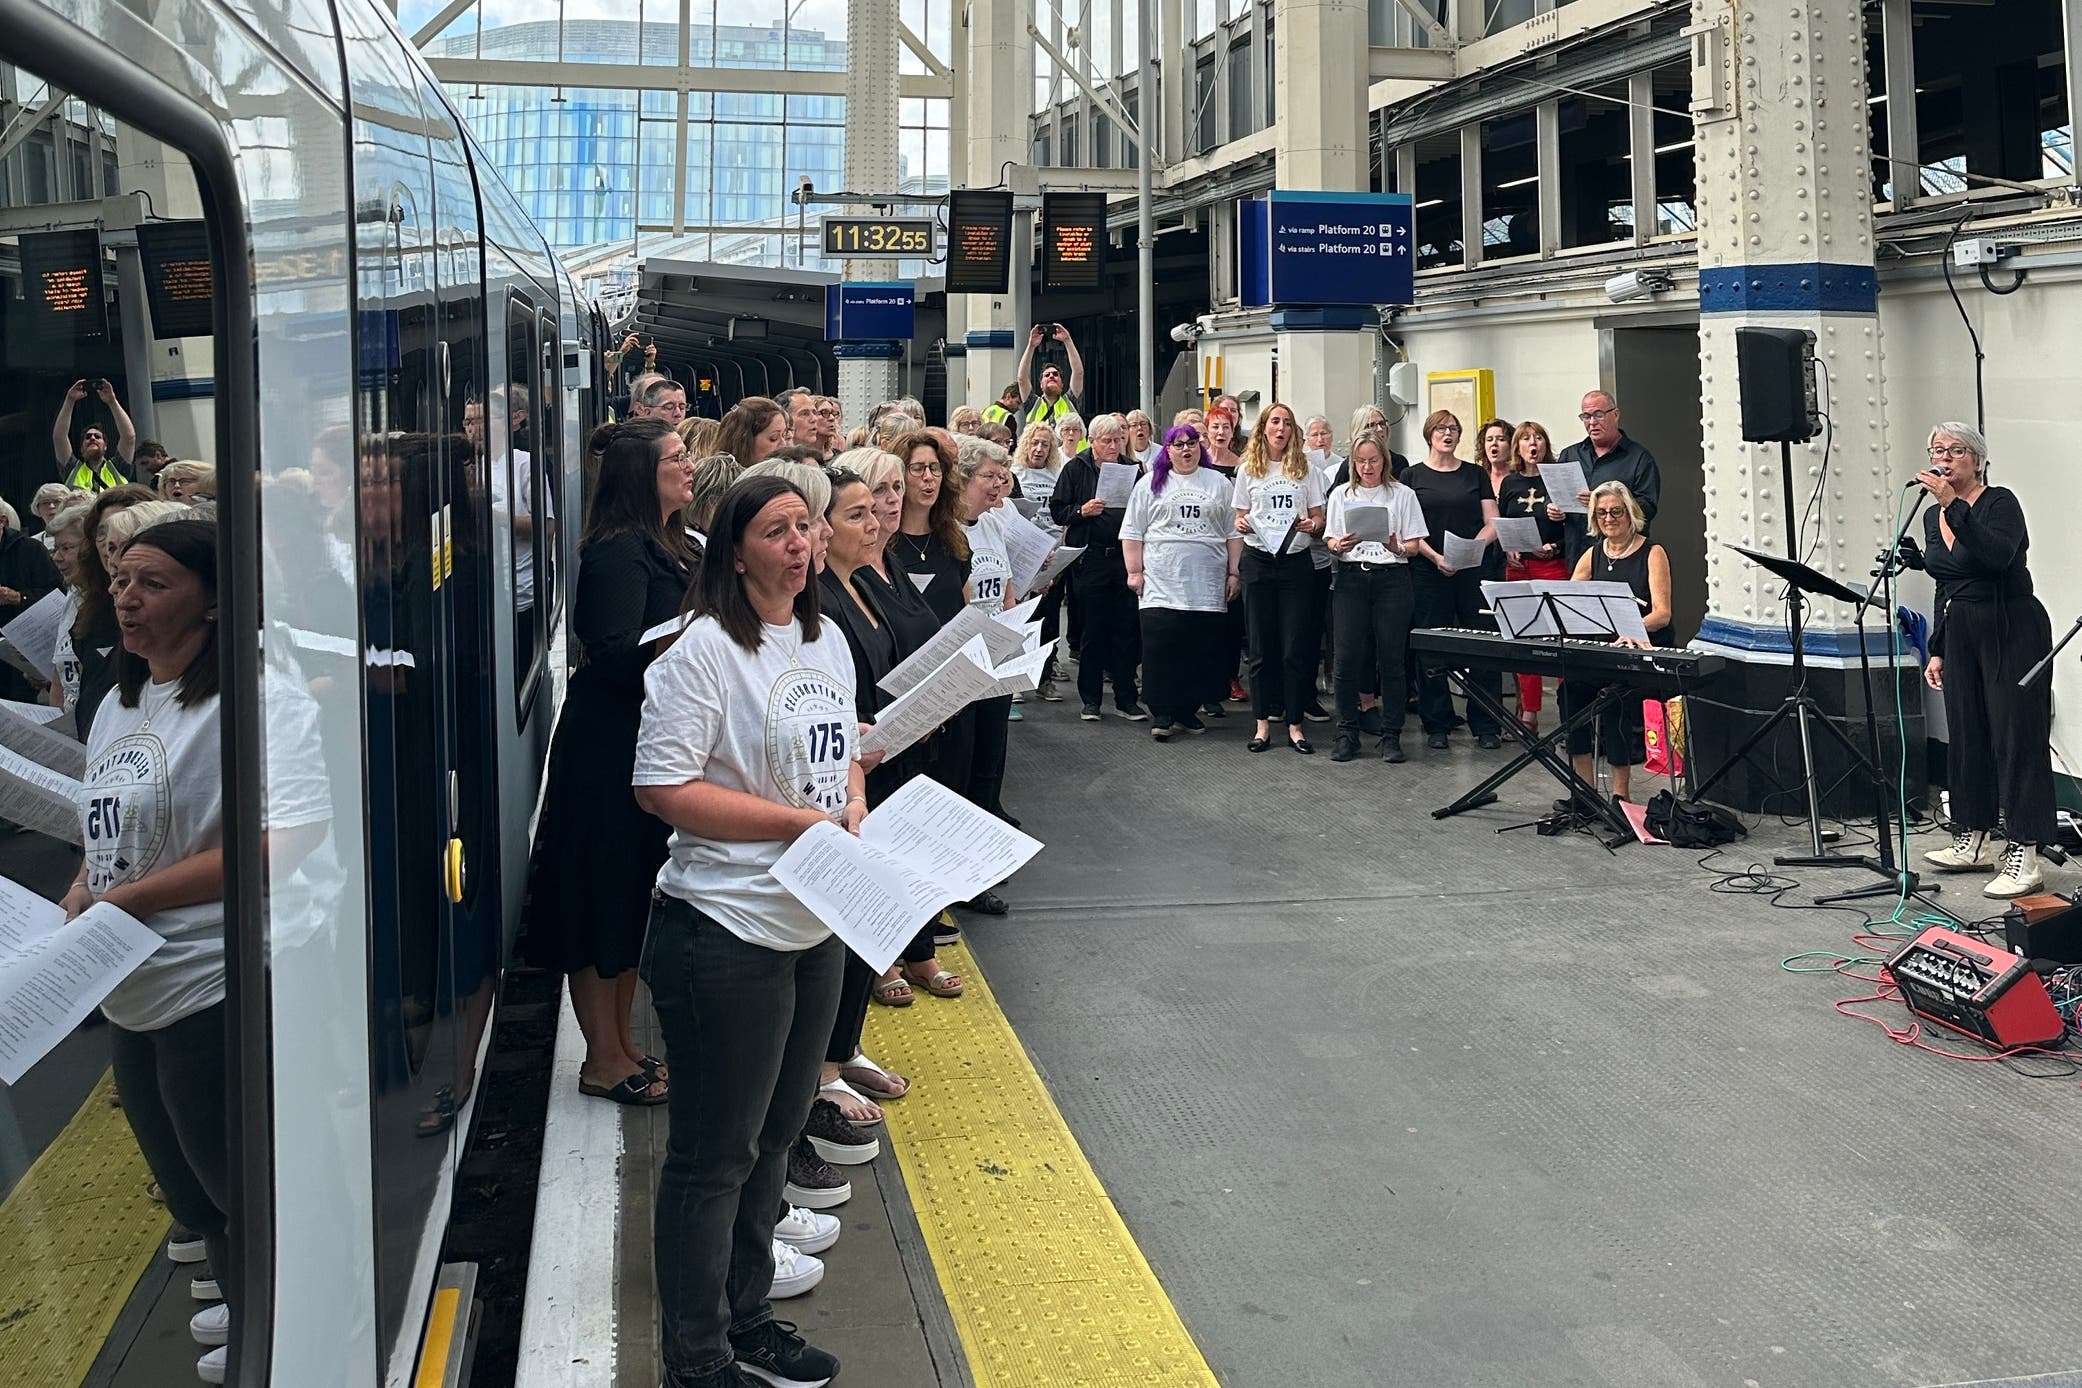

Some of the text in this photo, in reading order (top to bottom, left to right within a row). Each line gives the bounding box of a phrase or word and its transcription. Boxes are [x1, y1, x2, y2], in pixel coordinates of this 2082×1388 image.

[832, 226, 927, 250] 11:32 55
[1318, 224, 1360, 235] Platform
[1362, 225, 1376, 235] 20
[1319, 243, 1361, 254] Platform
[1363, 244, 1376, 254] 20
[1271, 495, 1292, 508] 175
[1180, 505, 1200, 518] 175
[978, 577, 1000, 598] 175
[785, 684, 843, 712] CELEBRATING
[809, 722, 844, 763] 175
